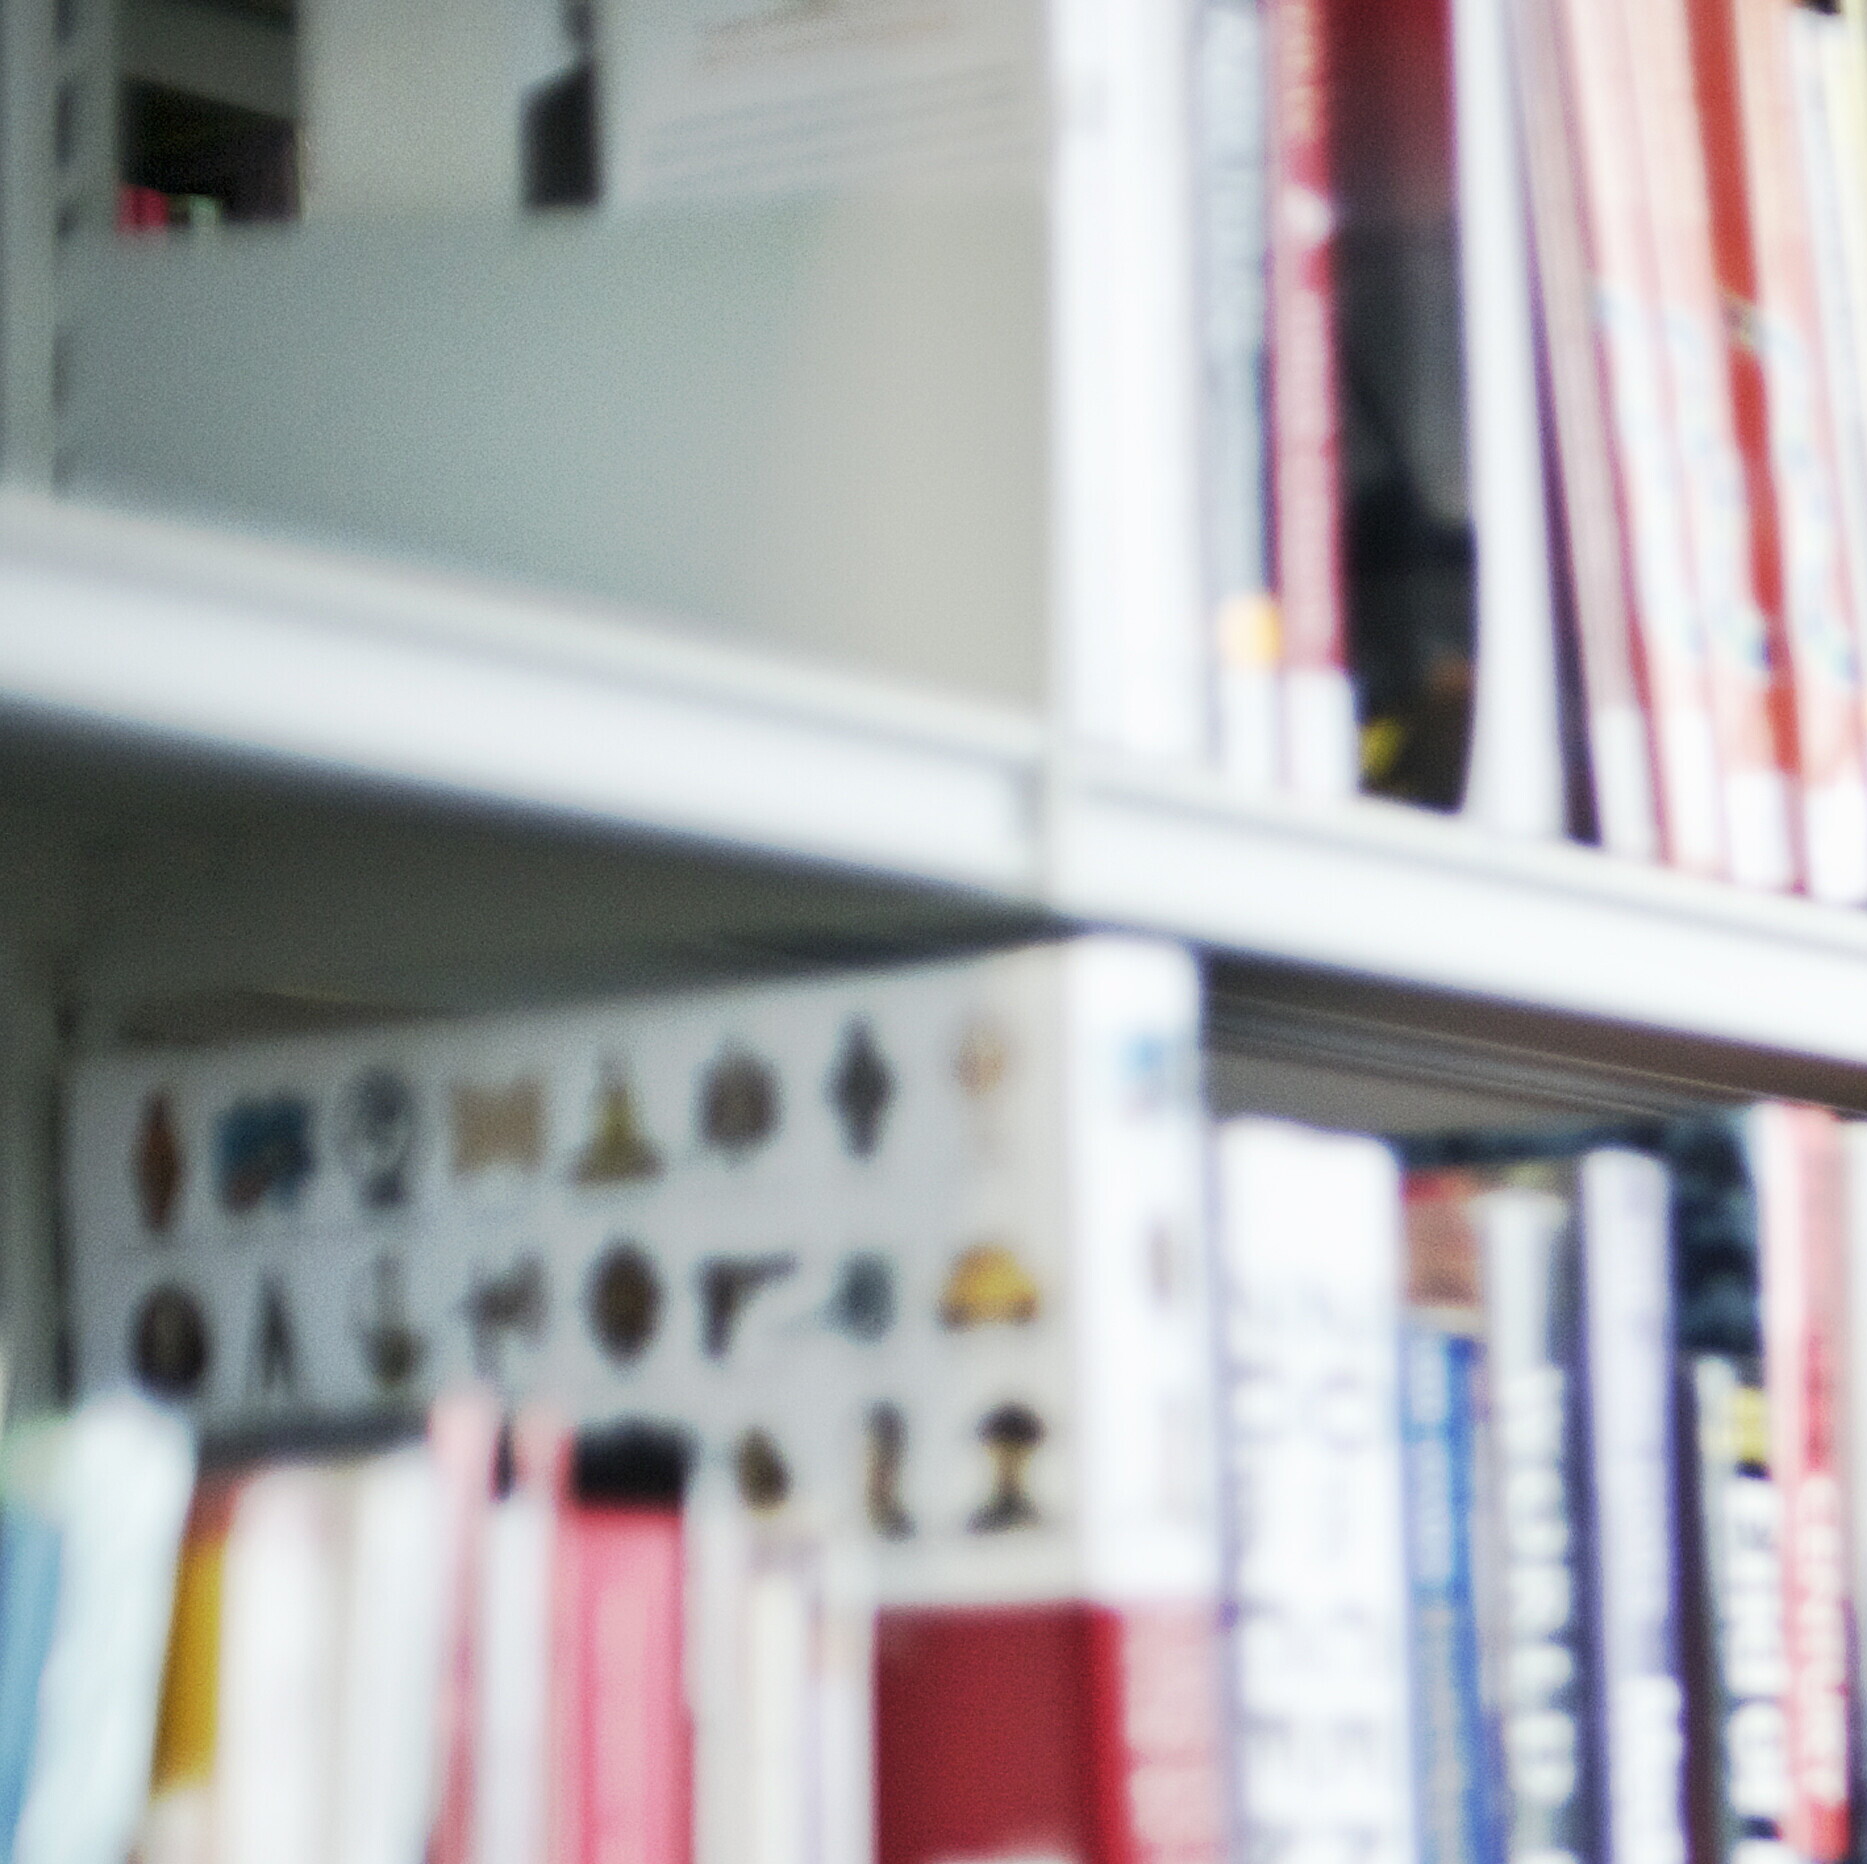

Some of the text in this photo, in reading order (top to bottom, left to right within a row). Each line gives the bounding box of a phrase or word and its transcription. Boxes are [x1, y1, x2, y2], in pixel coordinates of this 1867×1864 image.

[1503, 1363, 1582, 1805] WORLD
[1722, 1480, 1792, 1699] End
[1796, 1473, 1849, 1805] CENTURY
[1726, 1702, 1795, 1817] of
